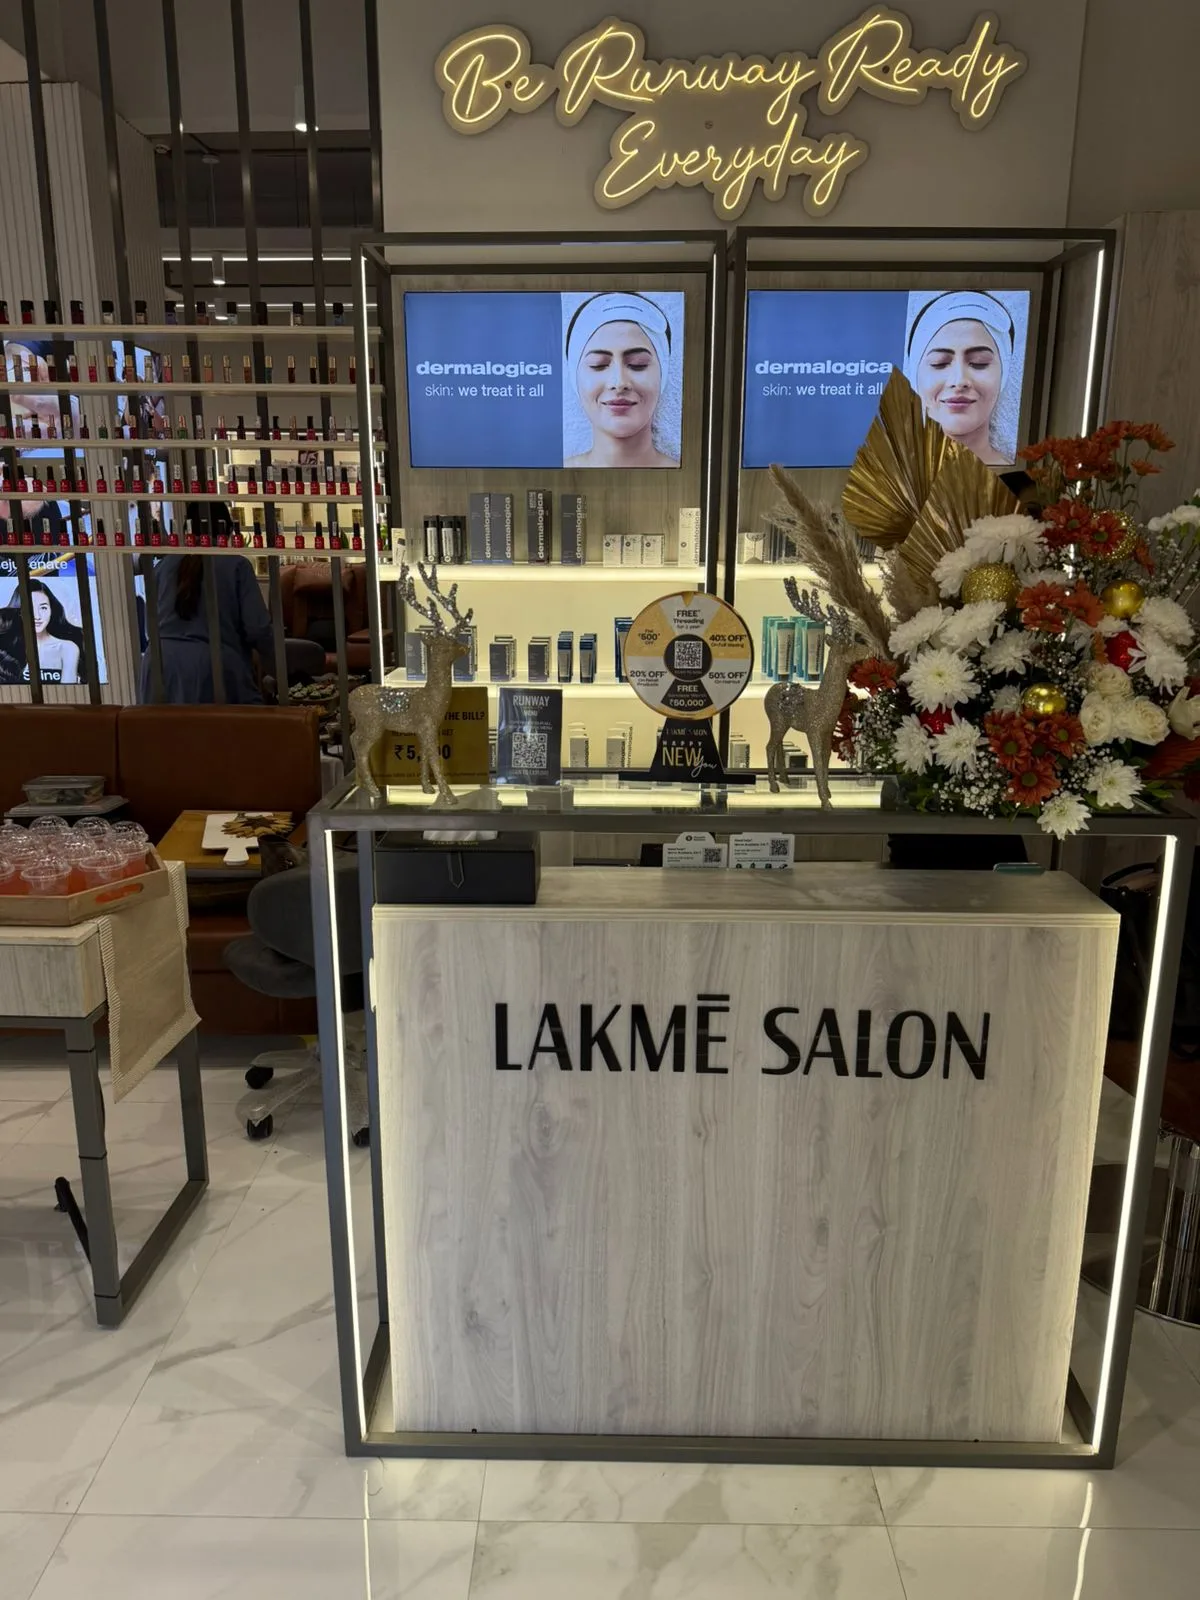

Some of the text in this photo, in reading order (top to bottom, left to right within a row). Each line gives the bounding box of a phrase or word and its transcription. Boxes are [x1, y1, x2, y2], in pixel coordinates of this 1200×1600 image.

[444, 13, 1018, 125] Be Runway Ready
[603, 113, 858, 209] Everyday
[416, 361, 552, 377] dermalogica
[755, 360, 893, 376] dermalogica
[425, 384, 544, 397] skin: we treat it all
[763, 384, 883, 396] skin: we treat it all
[0, 559, 68, 572] ejuenate
[709, 634, 726, 642] 40%
[23, 669, 60, 681] Sine
[513, 695, 550, 706] RUNWAY
[462, 712, 485, 720] BILL?
[662, 746, 702, 767] NEW
[761, 1007, 991, 1080] SALON
